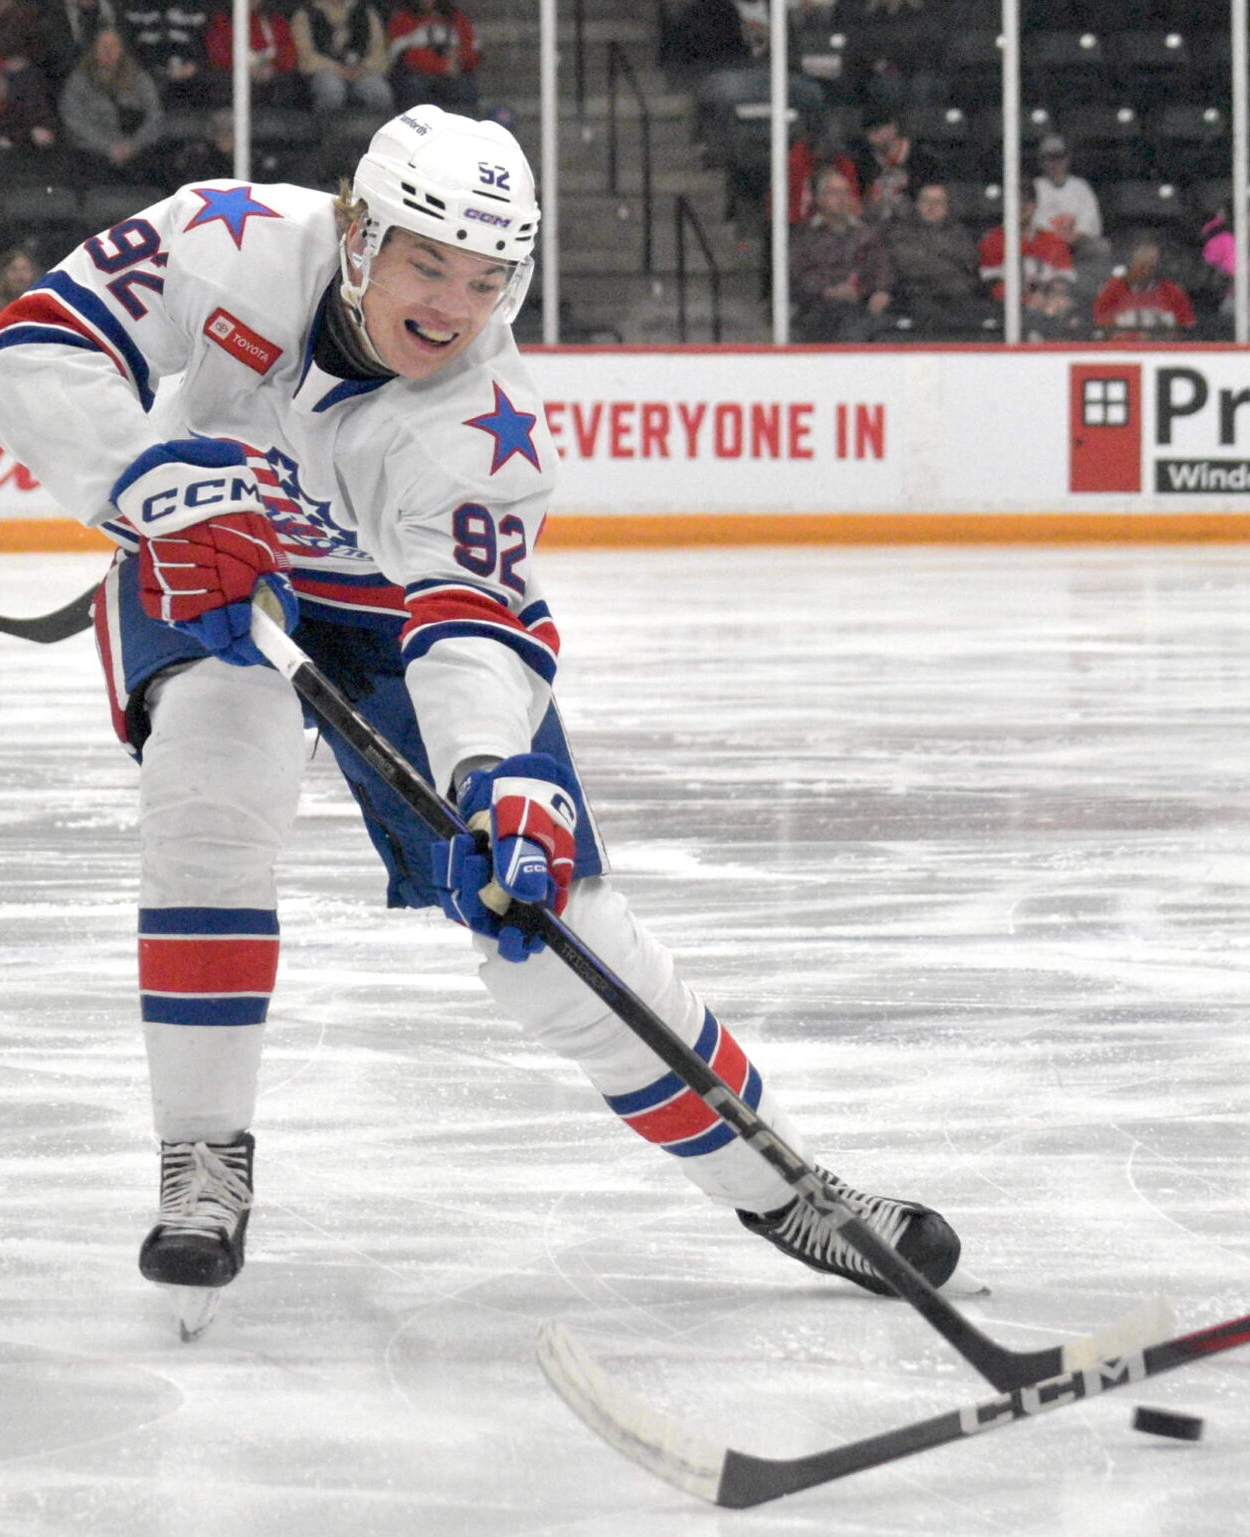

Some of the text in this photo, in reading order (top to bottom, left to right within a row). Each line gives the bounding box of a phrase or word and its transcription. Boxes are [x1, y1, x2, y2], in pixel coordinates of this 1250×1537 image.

[463, 207, 512, 228] CCM
[84, 218, 170, 322] 92
[232, 332, 270, 362] TOYOTA
[544, 400, 886, 460] EVERYONE IN
[141, 477, 262, 524] CCM
[1167, 463, 1250, 491] Wind
[451, 501, 527, 598] 92
[958, 1348, 1147, 1436] CCM
